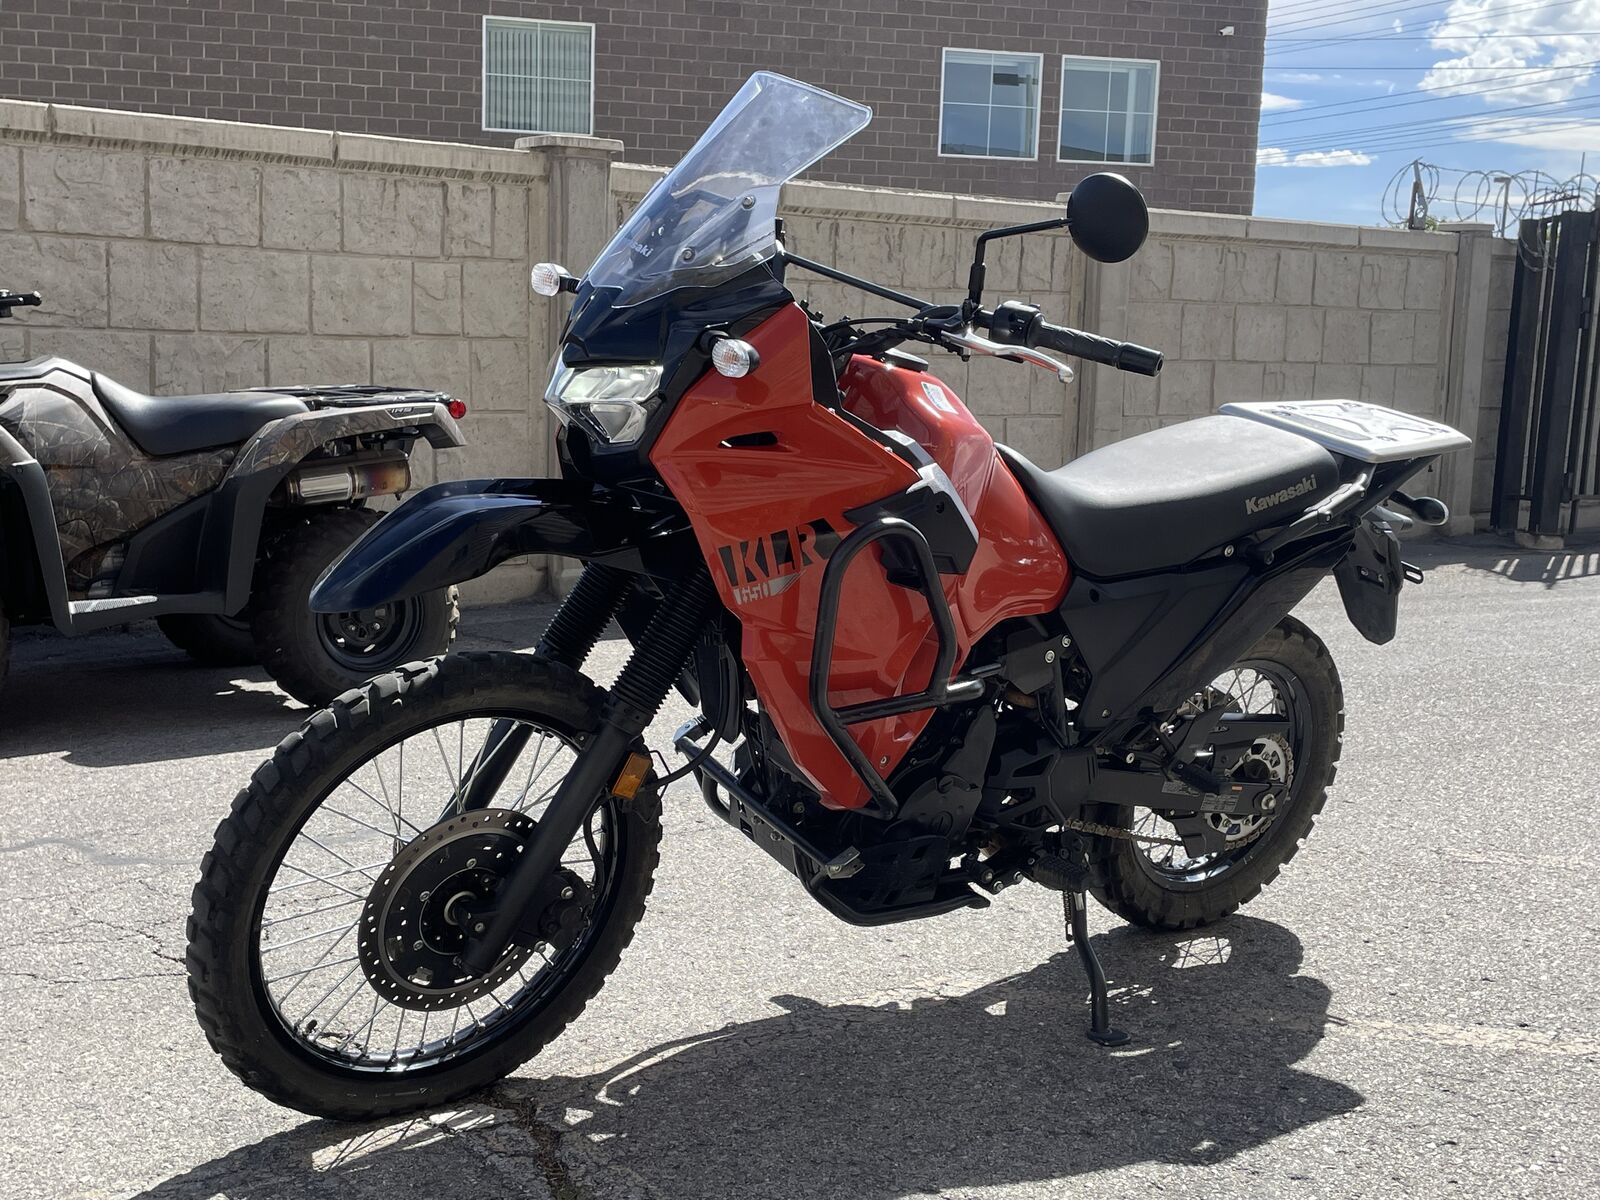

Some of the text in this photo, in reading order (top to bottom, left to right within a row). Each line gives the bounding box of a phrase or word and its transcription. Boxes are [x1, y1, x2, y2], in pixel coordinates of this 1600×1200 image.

[630, 241, 654, 258] saki
[1245, 474, 1317, 515] Kawasaki
[727, 521, 831, 585] KLR
[737, 582, 771, 605] 650
